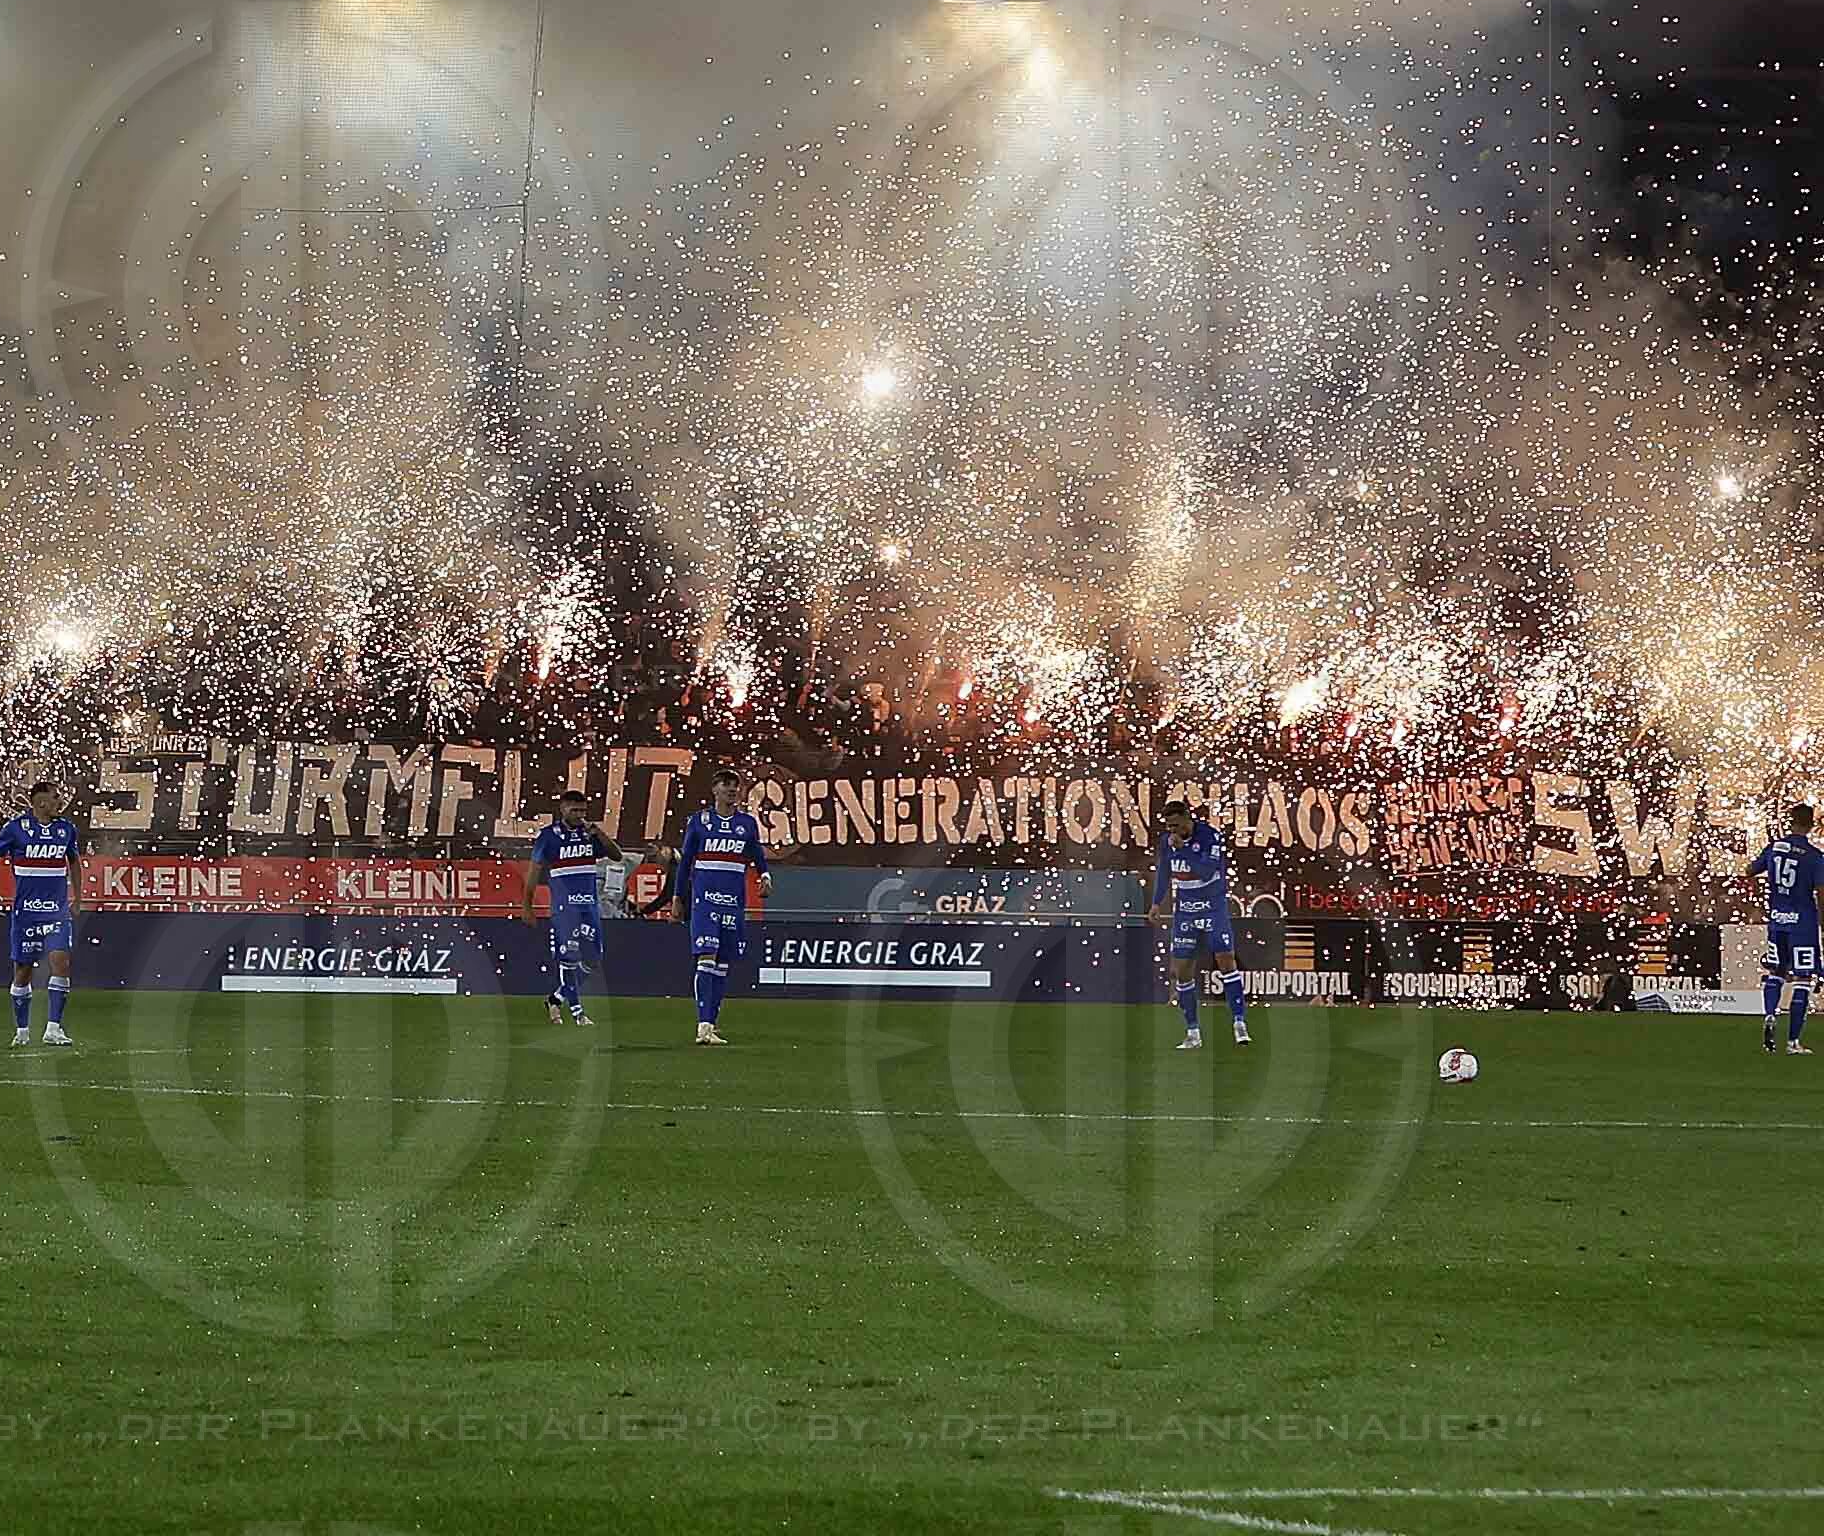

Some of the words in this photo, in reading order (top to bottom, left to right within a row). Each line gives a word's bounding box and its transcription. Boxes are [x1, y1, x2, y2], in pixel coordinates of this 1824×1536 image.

[88, 741, 693, 838] STURMFLUT
[752, 777, 1151, 848] GENERATION
[103, 866, 243, 897] KLEINE
[337, 869, 481, 901] KLEINE
[1773, 855, 1798, 888] 15
[936, 895, 1007, 914] GRAZ
[243, 946, 365, 970] ENERGIE
[376, 947, 453, 973] GRAZ
[780, 939, 898, 964] ENERGIE
[909, 942, 986, 966] GRAZ
[1210, 969, 1352, 996] SUNDPORTAL
